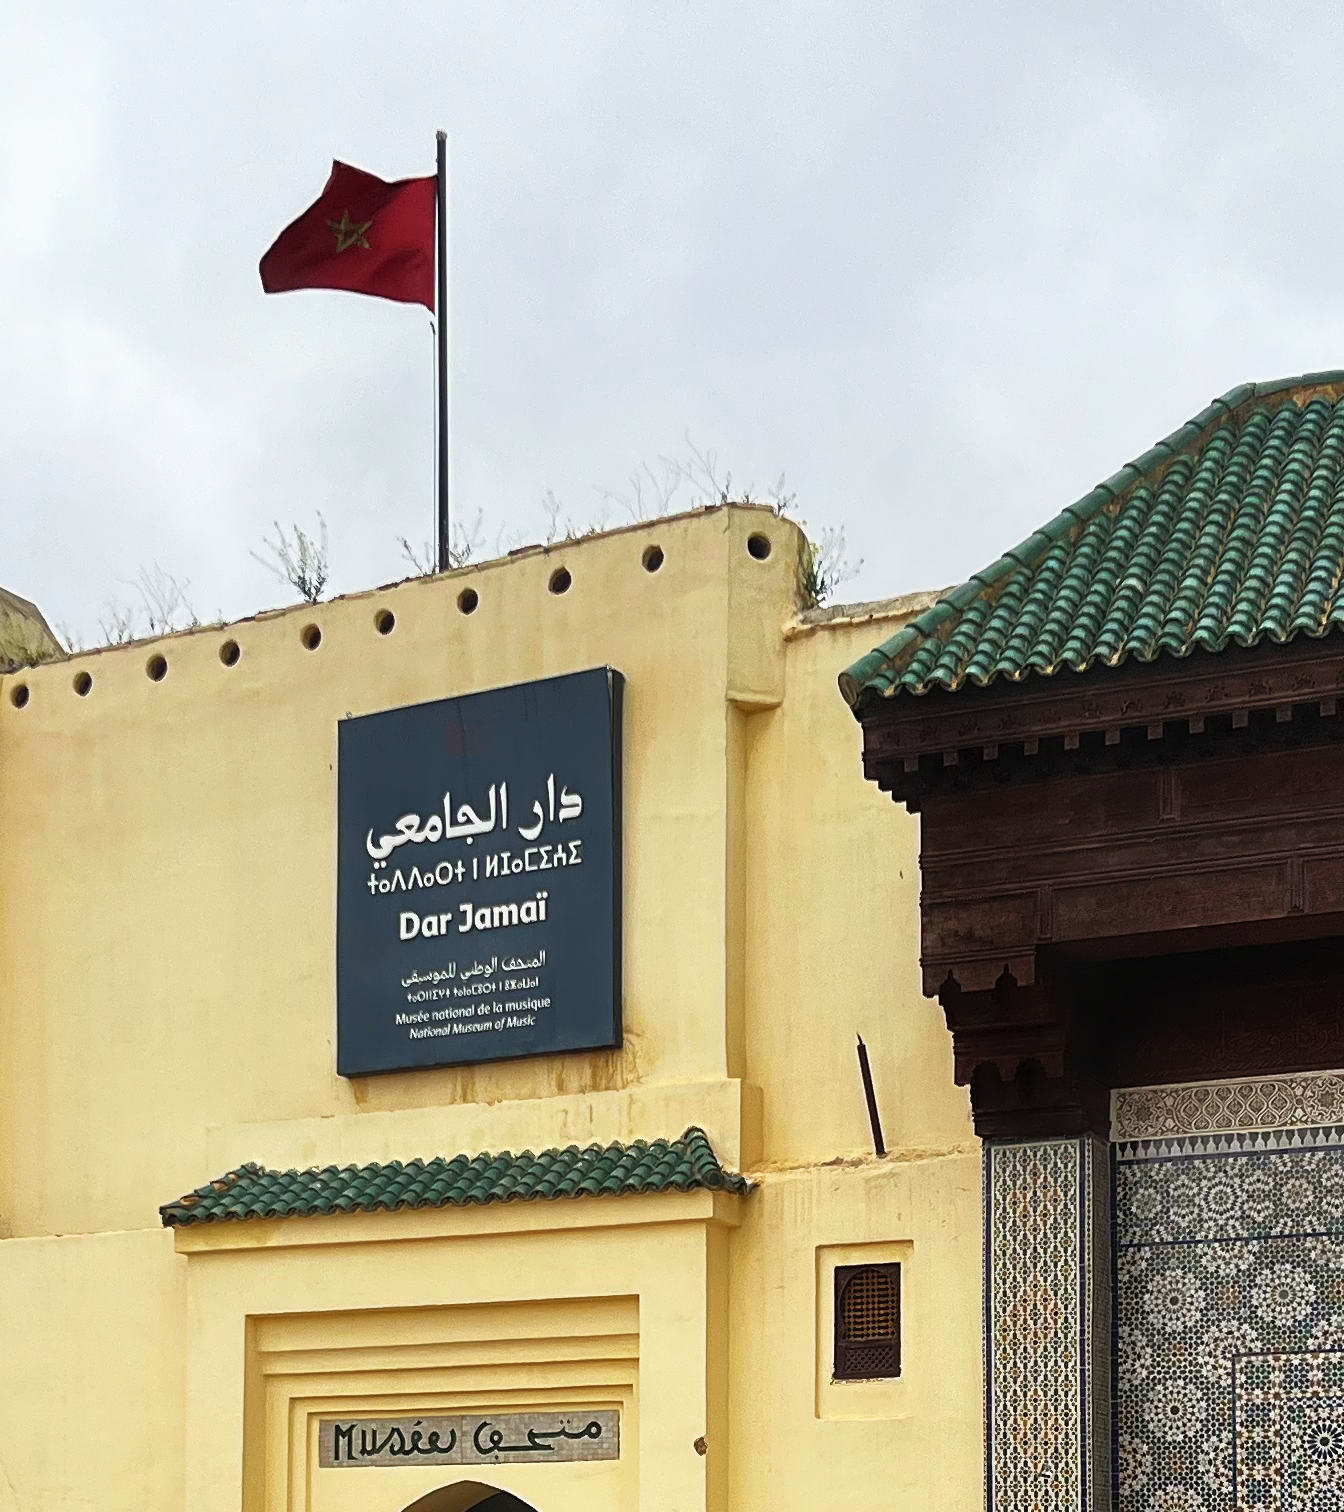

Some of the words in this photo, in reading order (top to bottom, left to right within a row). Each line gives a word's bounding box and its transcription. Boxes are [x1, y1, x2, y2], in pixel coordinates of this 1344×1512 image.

[518, 773, 582, 840] دار
[366, 781, 507, 869] الجامعي
[399, 911, 452, 941] Dar
[458, 891, 548, 933] Jamaï
[460, 956, 498, 982] الوطني
[501, 950, 546, 971] المتحف
[395, 1010, 430, 1025] Musée
[432, 1004, 475, 1021] national
[477, 1003, 491, 1016] de
[493, 1000, 503, 1013] la
[505, 996, 551, 1012] musique
[409, 1023, 451, 1040] National
[452, 1020, 493, 1035] Museum
[495, 1016, 506, 1031] of
[506, 1014, 536, 1028] Music
[334, 1420, 456, 1460] Musée
